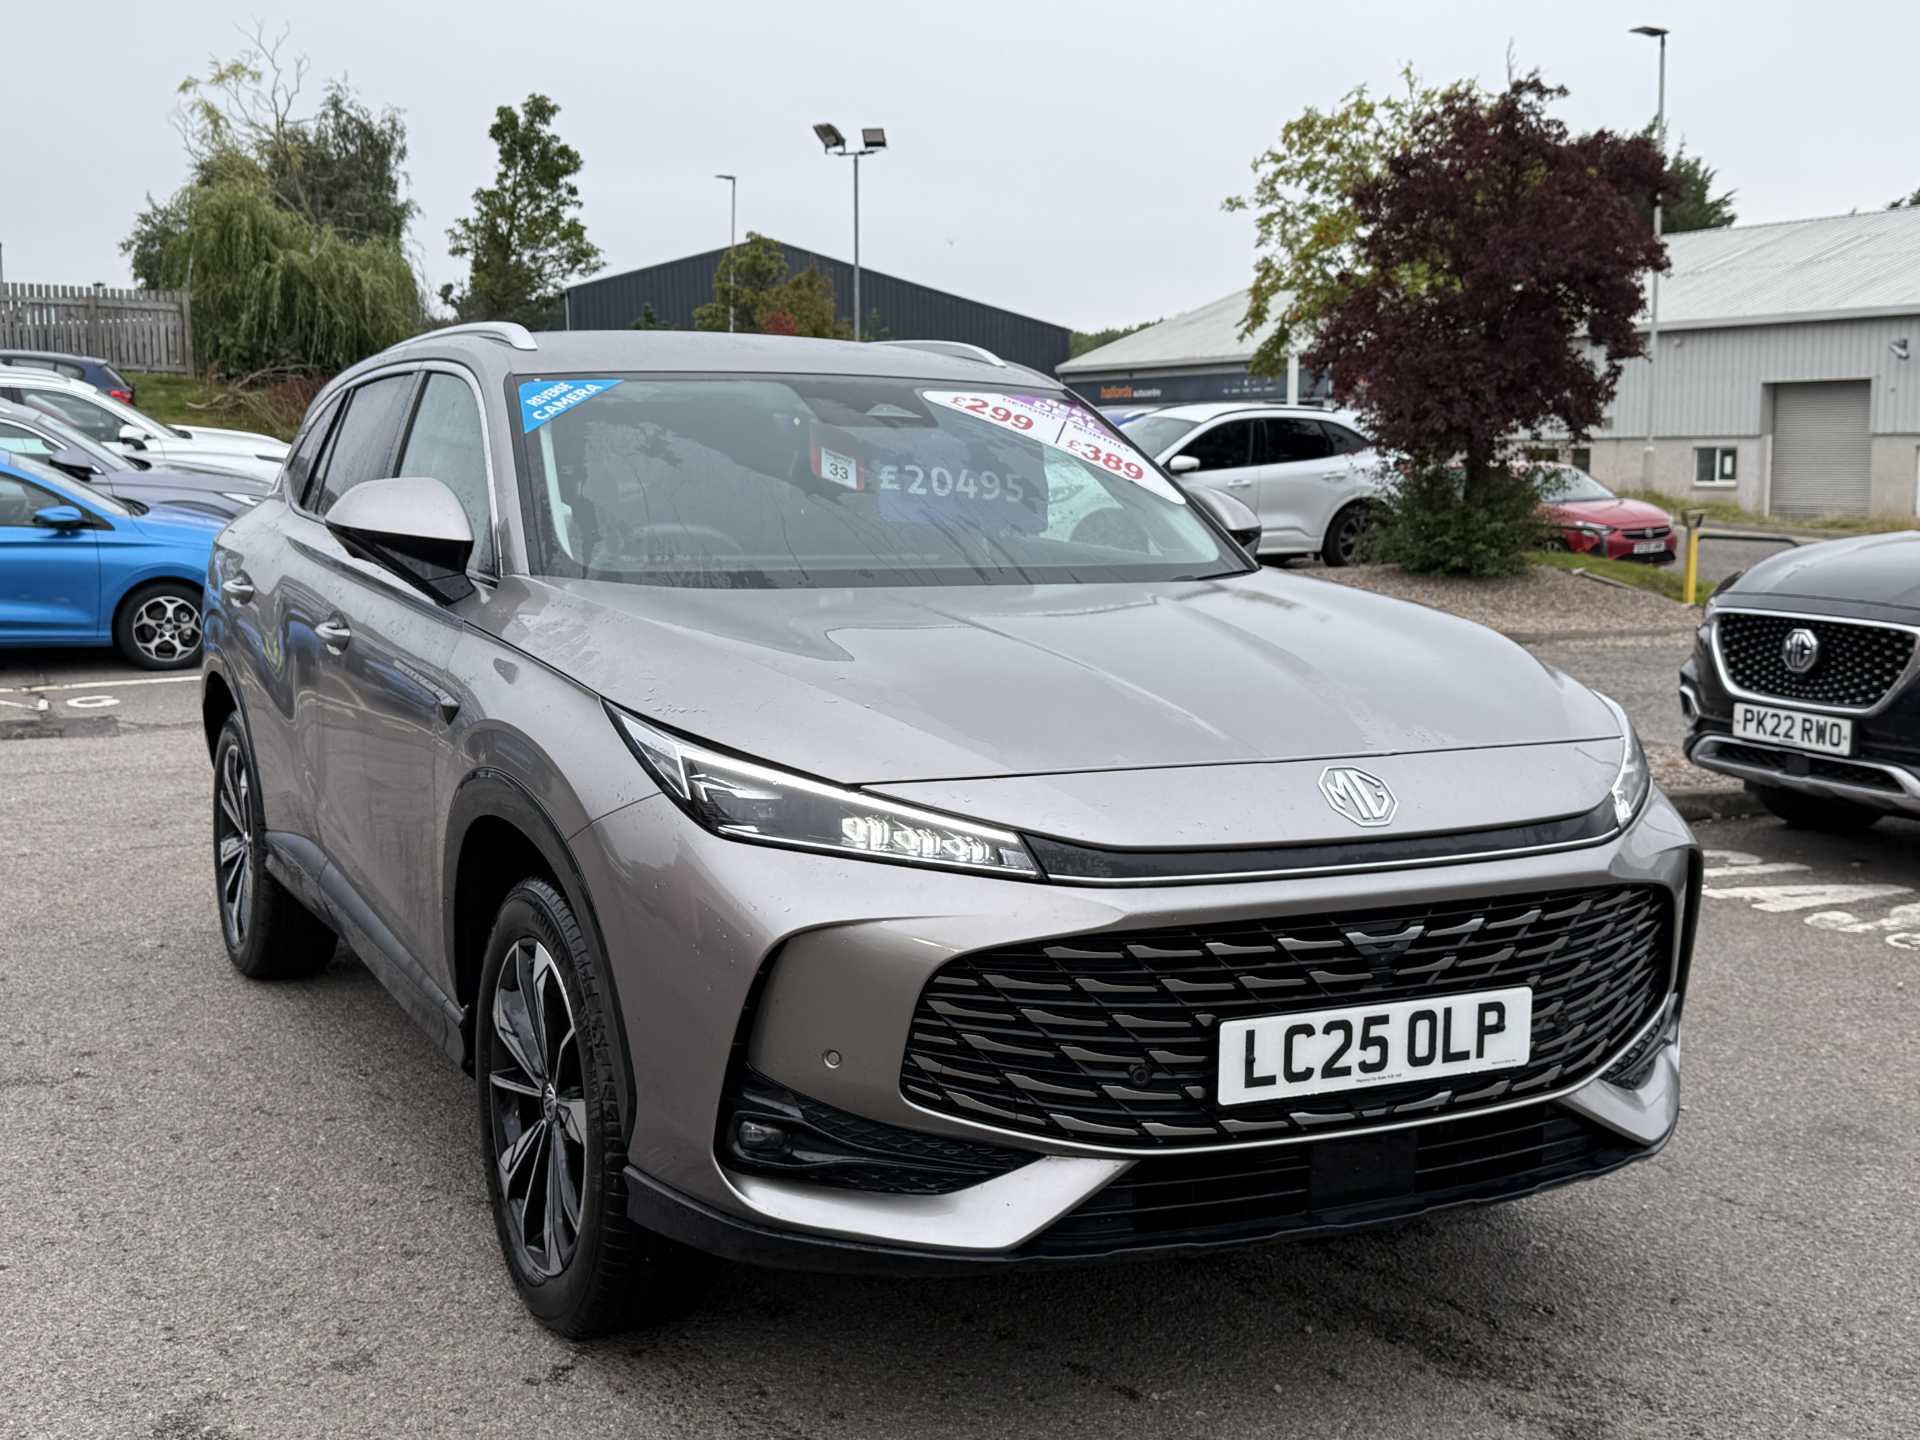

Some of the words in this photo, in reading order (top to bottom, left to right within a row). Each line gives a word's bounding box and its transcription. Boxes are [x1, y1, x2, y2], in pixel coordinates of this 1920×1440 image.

[532, 384, 603, 420] CAMERA
[950, 396, 1034, 431] £299
[829, 462, 849, 480] 33
[1066, 439, 1144, 480] £389
[880, 464, 1024, 502] £20495
[1742, 708, 1795, 739] PK22
[1800, 717, 1842, 747] RWO
[1323, 767, 1392, 821] MG
[1244, 1014, 1390, 1089] LC25
[1406, 1001, 1506, 1068] OLP
